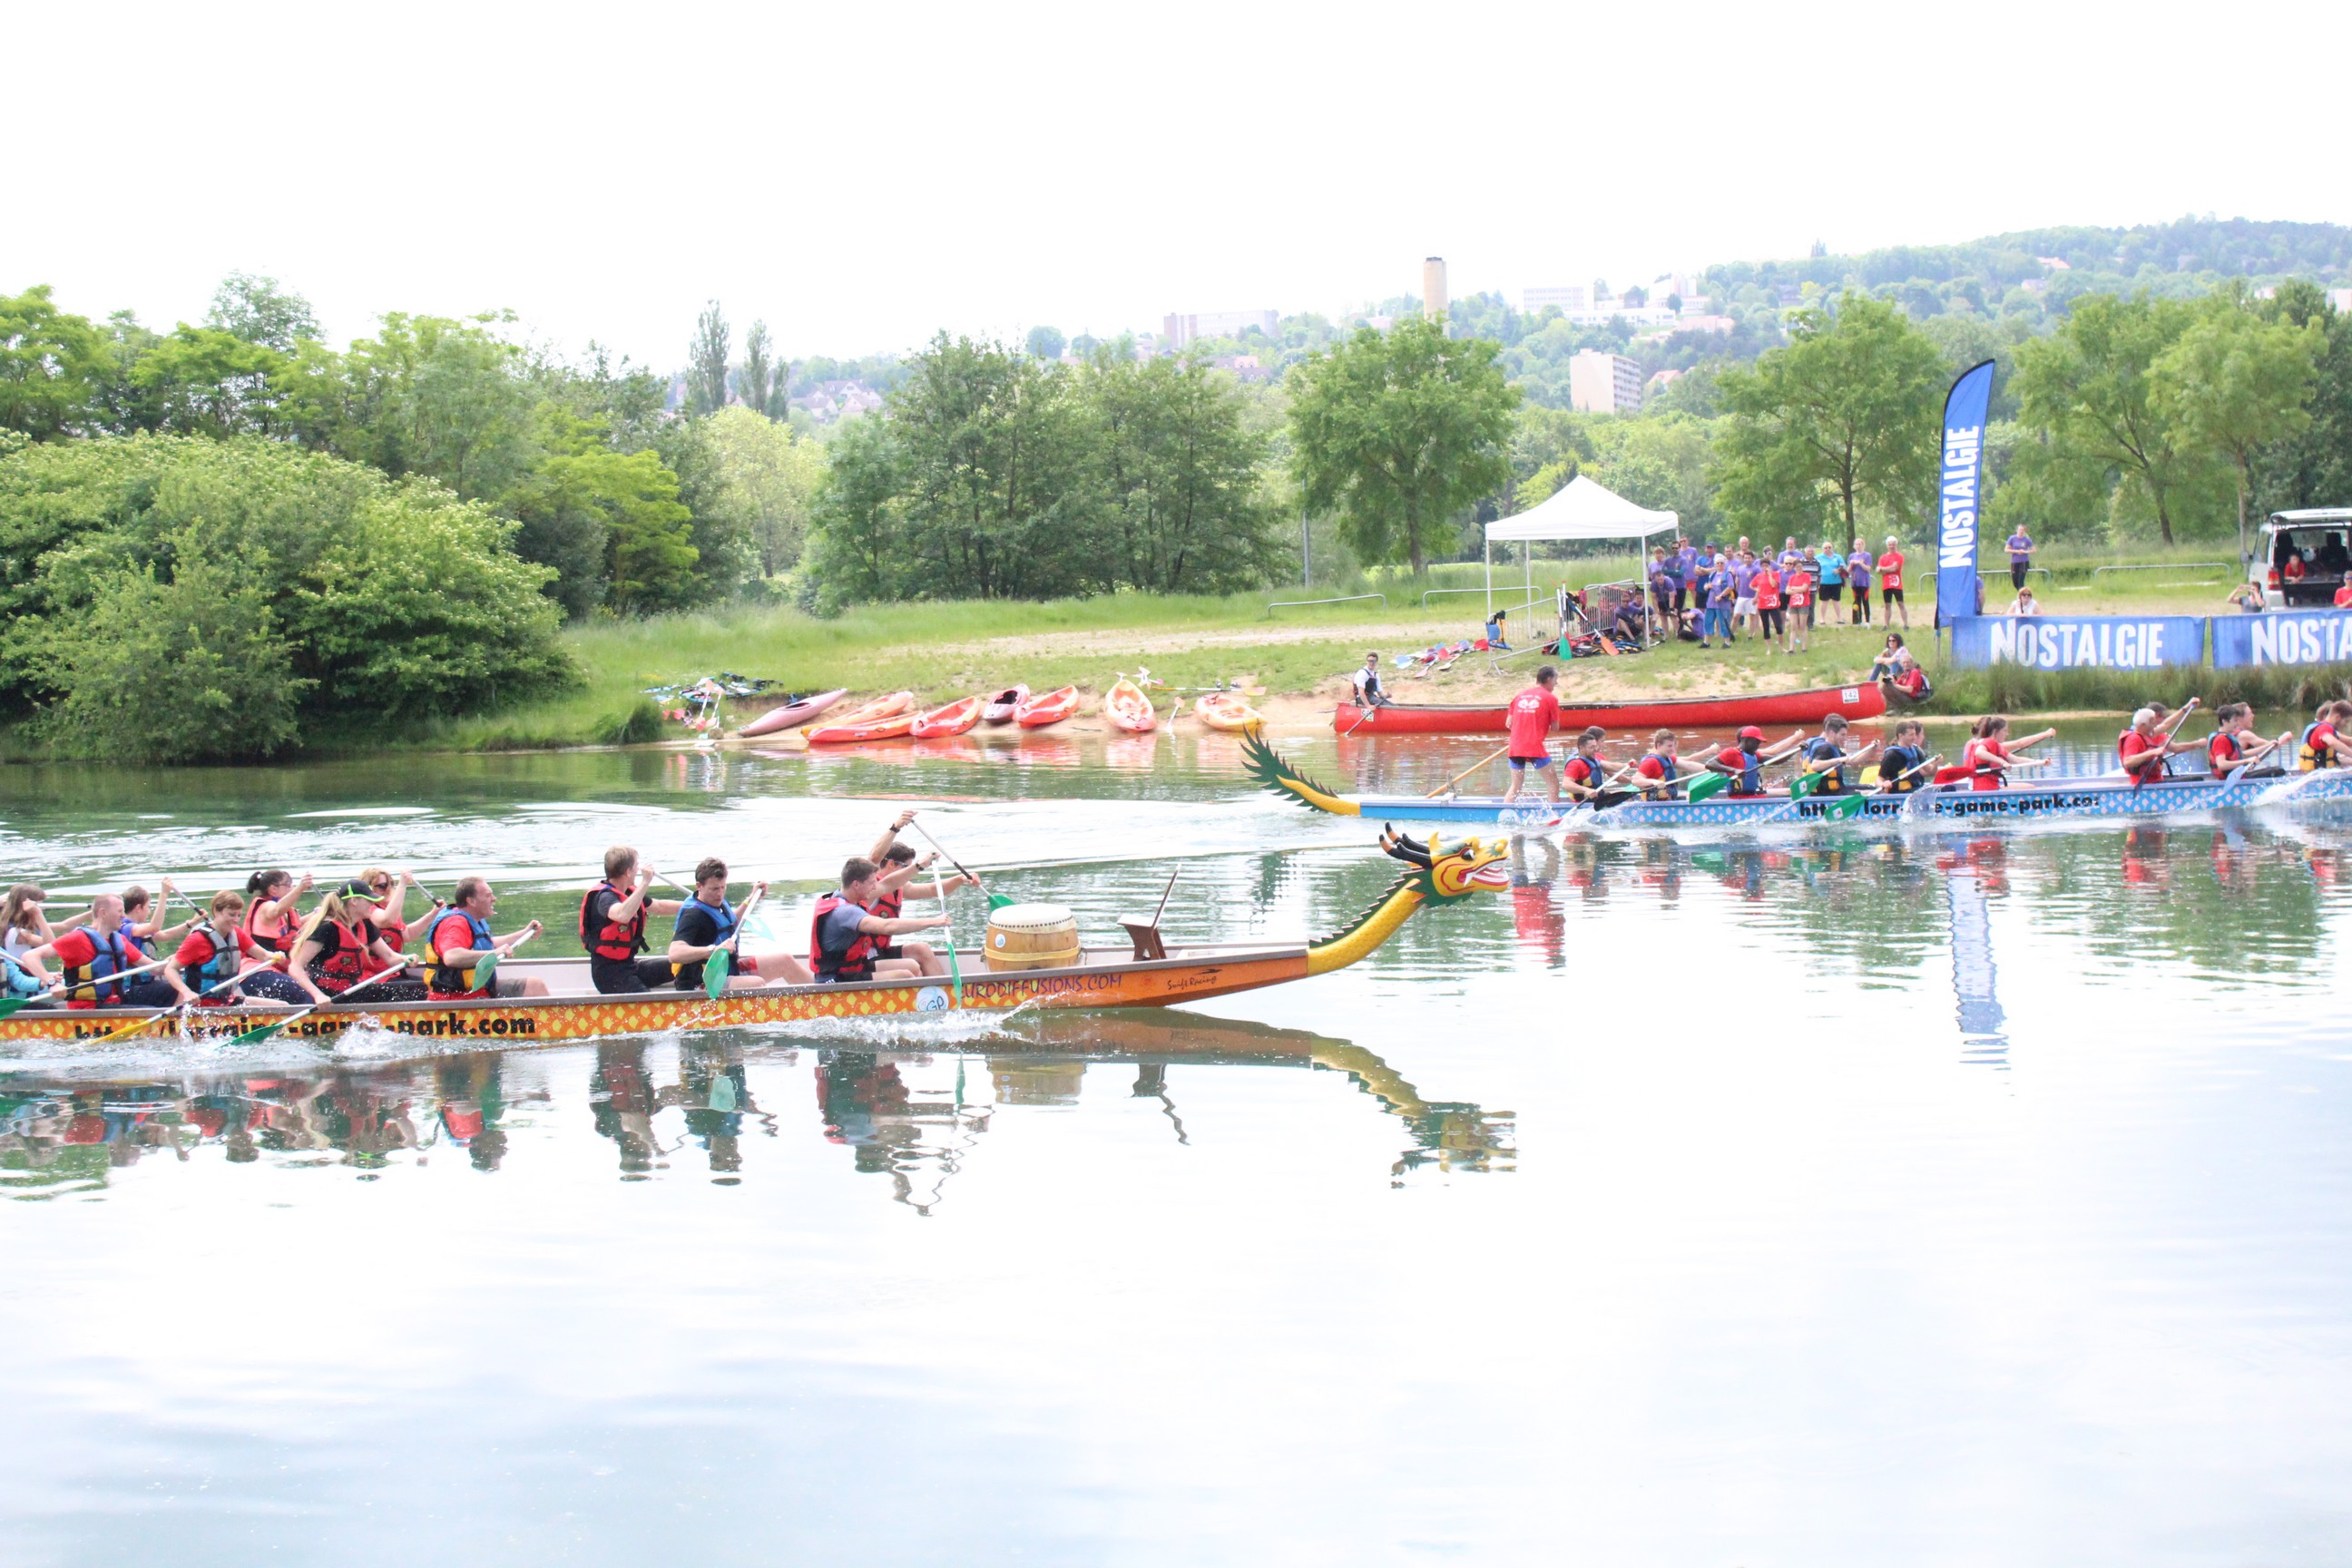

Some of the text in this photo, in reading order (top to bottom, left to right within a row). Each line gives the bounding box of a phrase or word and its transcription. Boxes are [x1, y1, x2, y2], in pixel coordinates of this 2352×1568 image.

[1939, 426, 1979, 568] NOSTALGIE
[1990, 618, 2164, 669] NOSTALGIE
[2251, 615, 2352, 667] NOSTA
